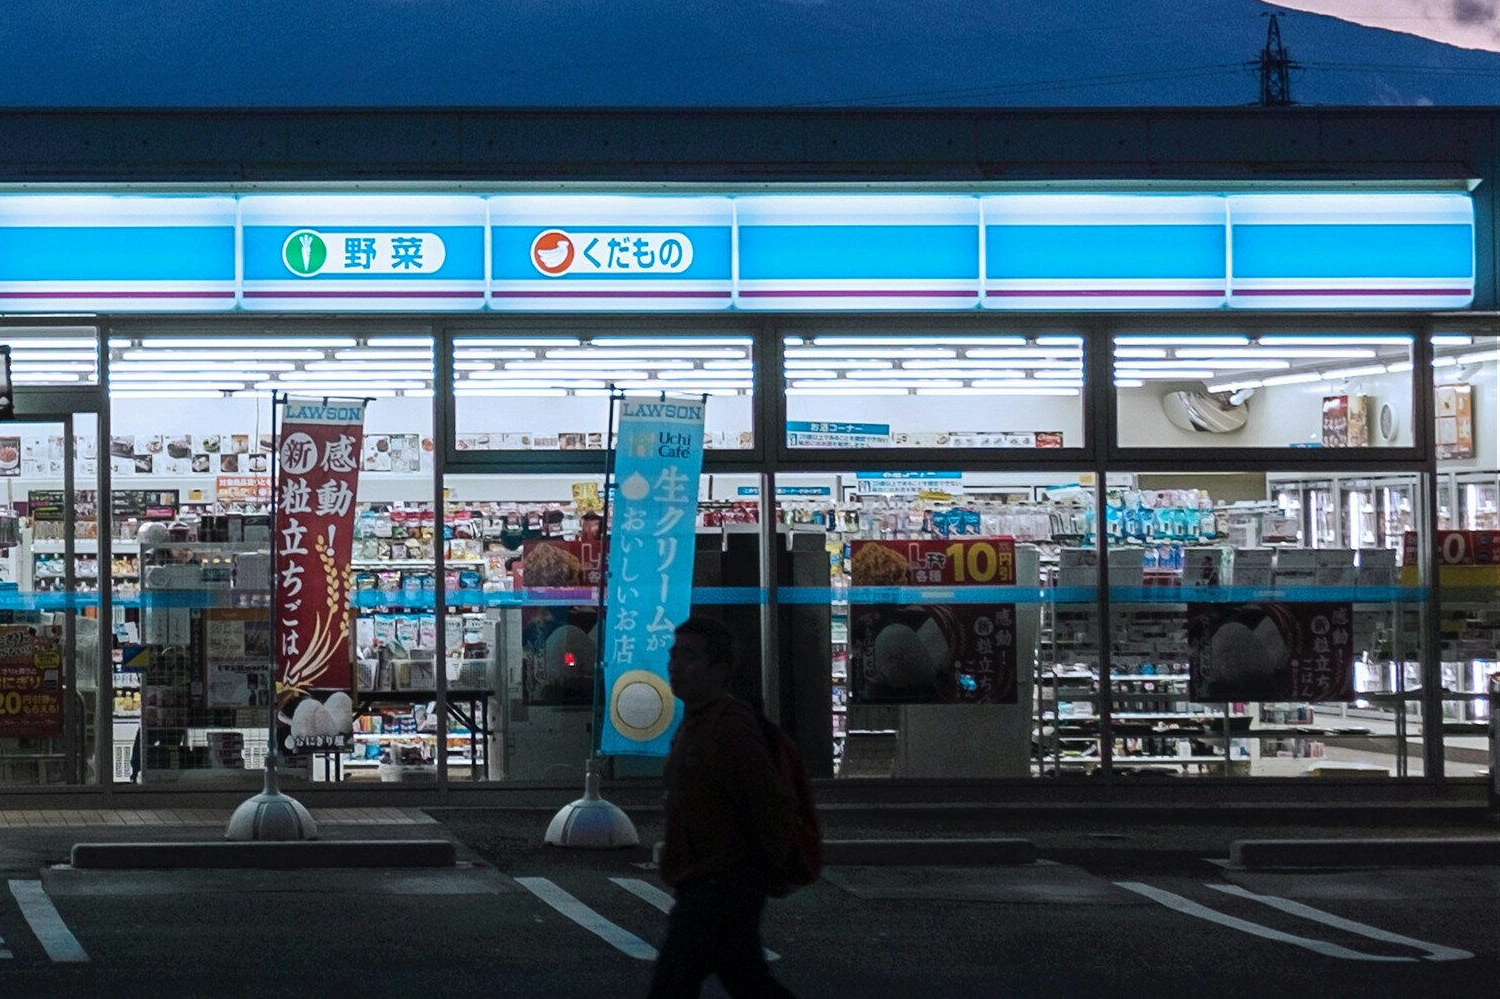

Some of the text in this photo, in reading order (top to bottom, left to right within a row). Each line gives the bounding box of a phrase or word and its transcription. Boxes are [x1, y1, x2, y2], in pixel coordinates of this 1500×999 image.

[344, 237, 423, 269] 野菜
[583, 237, 683, 269] くだもの
[285, 405, 362, 421] LAWSON
[622, 403, 702, 420] LAWSON
[658, 432, 691, 445] Uchi
[658, 445, 691, 458] Café
[646, 465, 690, 651] 生クリームが
[946, 542, 998, 582] 10
[613, 507, 647, 664] おいしいお店
[916, 571, 942, 583] 各種
